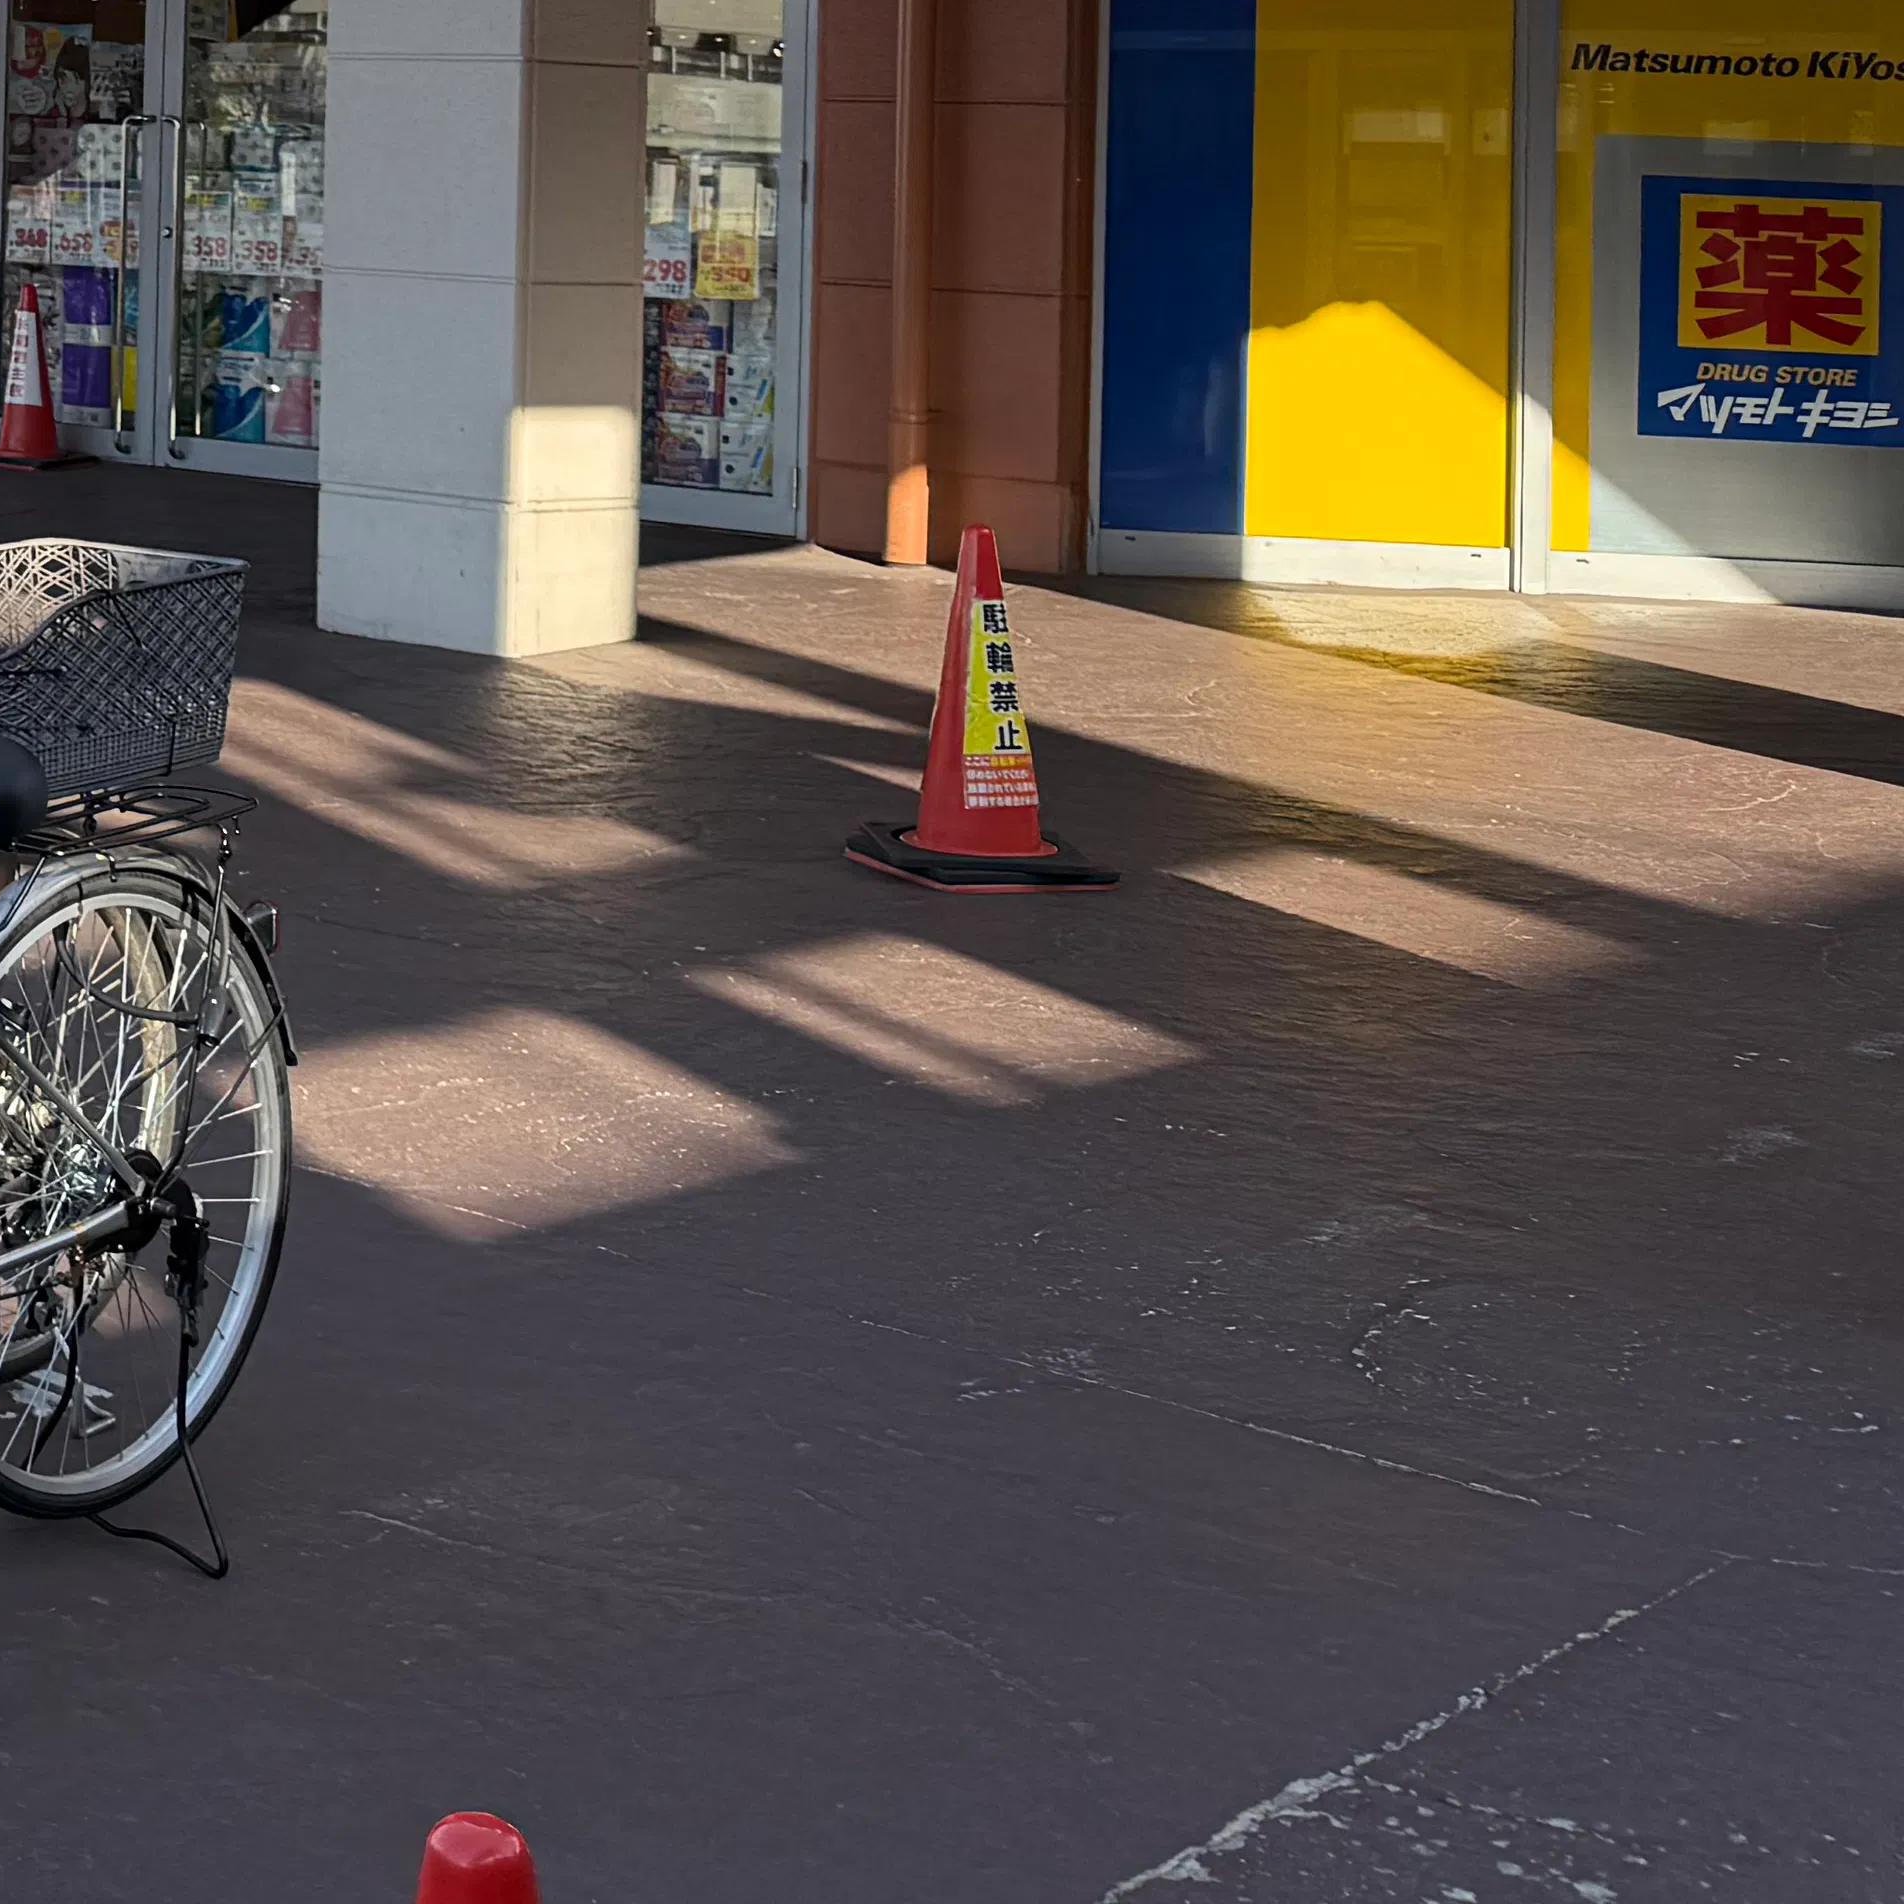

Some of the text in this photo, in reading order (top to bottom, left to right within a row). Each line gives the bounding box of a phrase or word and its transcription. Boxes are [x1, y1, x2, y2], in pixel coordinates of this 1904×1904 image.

[1571, 43, 1799, 81] Matsumoto
[644, 259, 686, 282] 298
[1696, 203, 1867, 347] 薬
[1697, 362, 1858, 386] DRUG STORE
[1656, 384, 1902, 438] マツモトキヨシ
[983, 604, 1023, 752] 駐輪禁止
